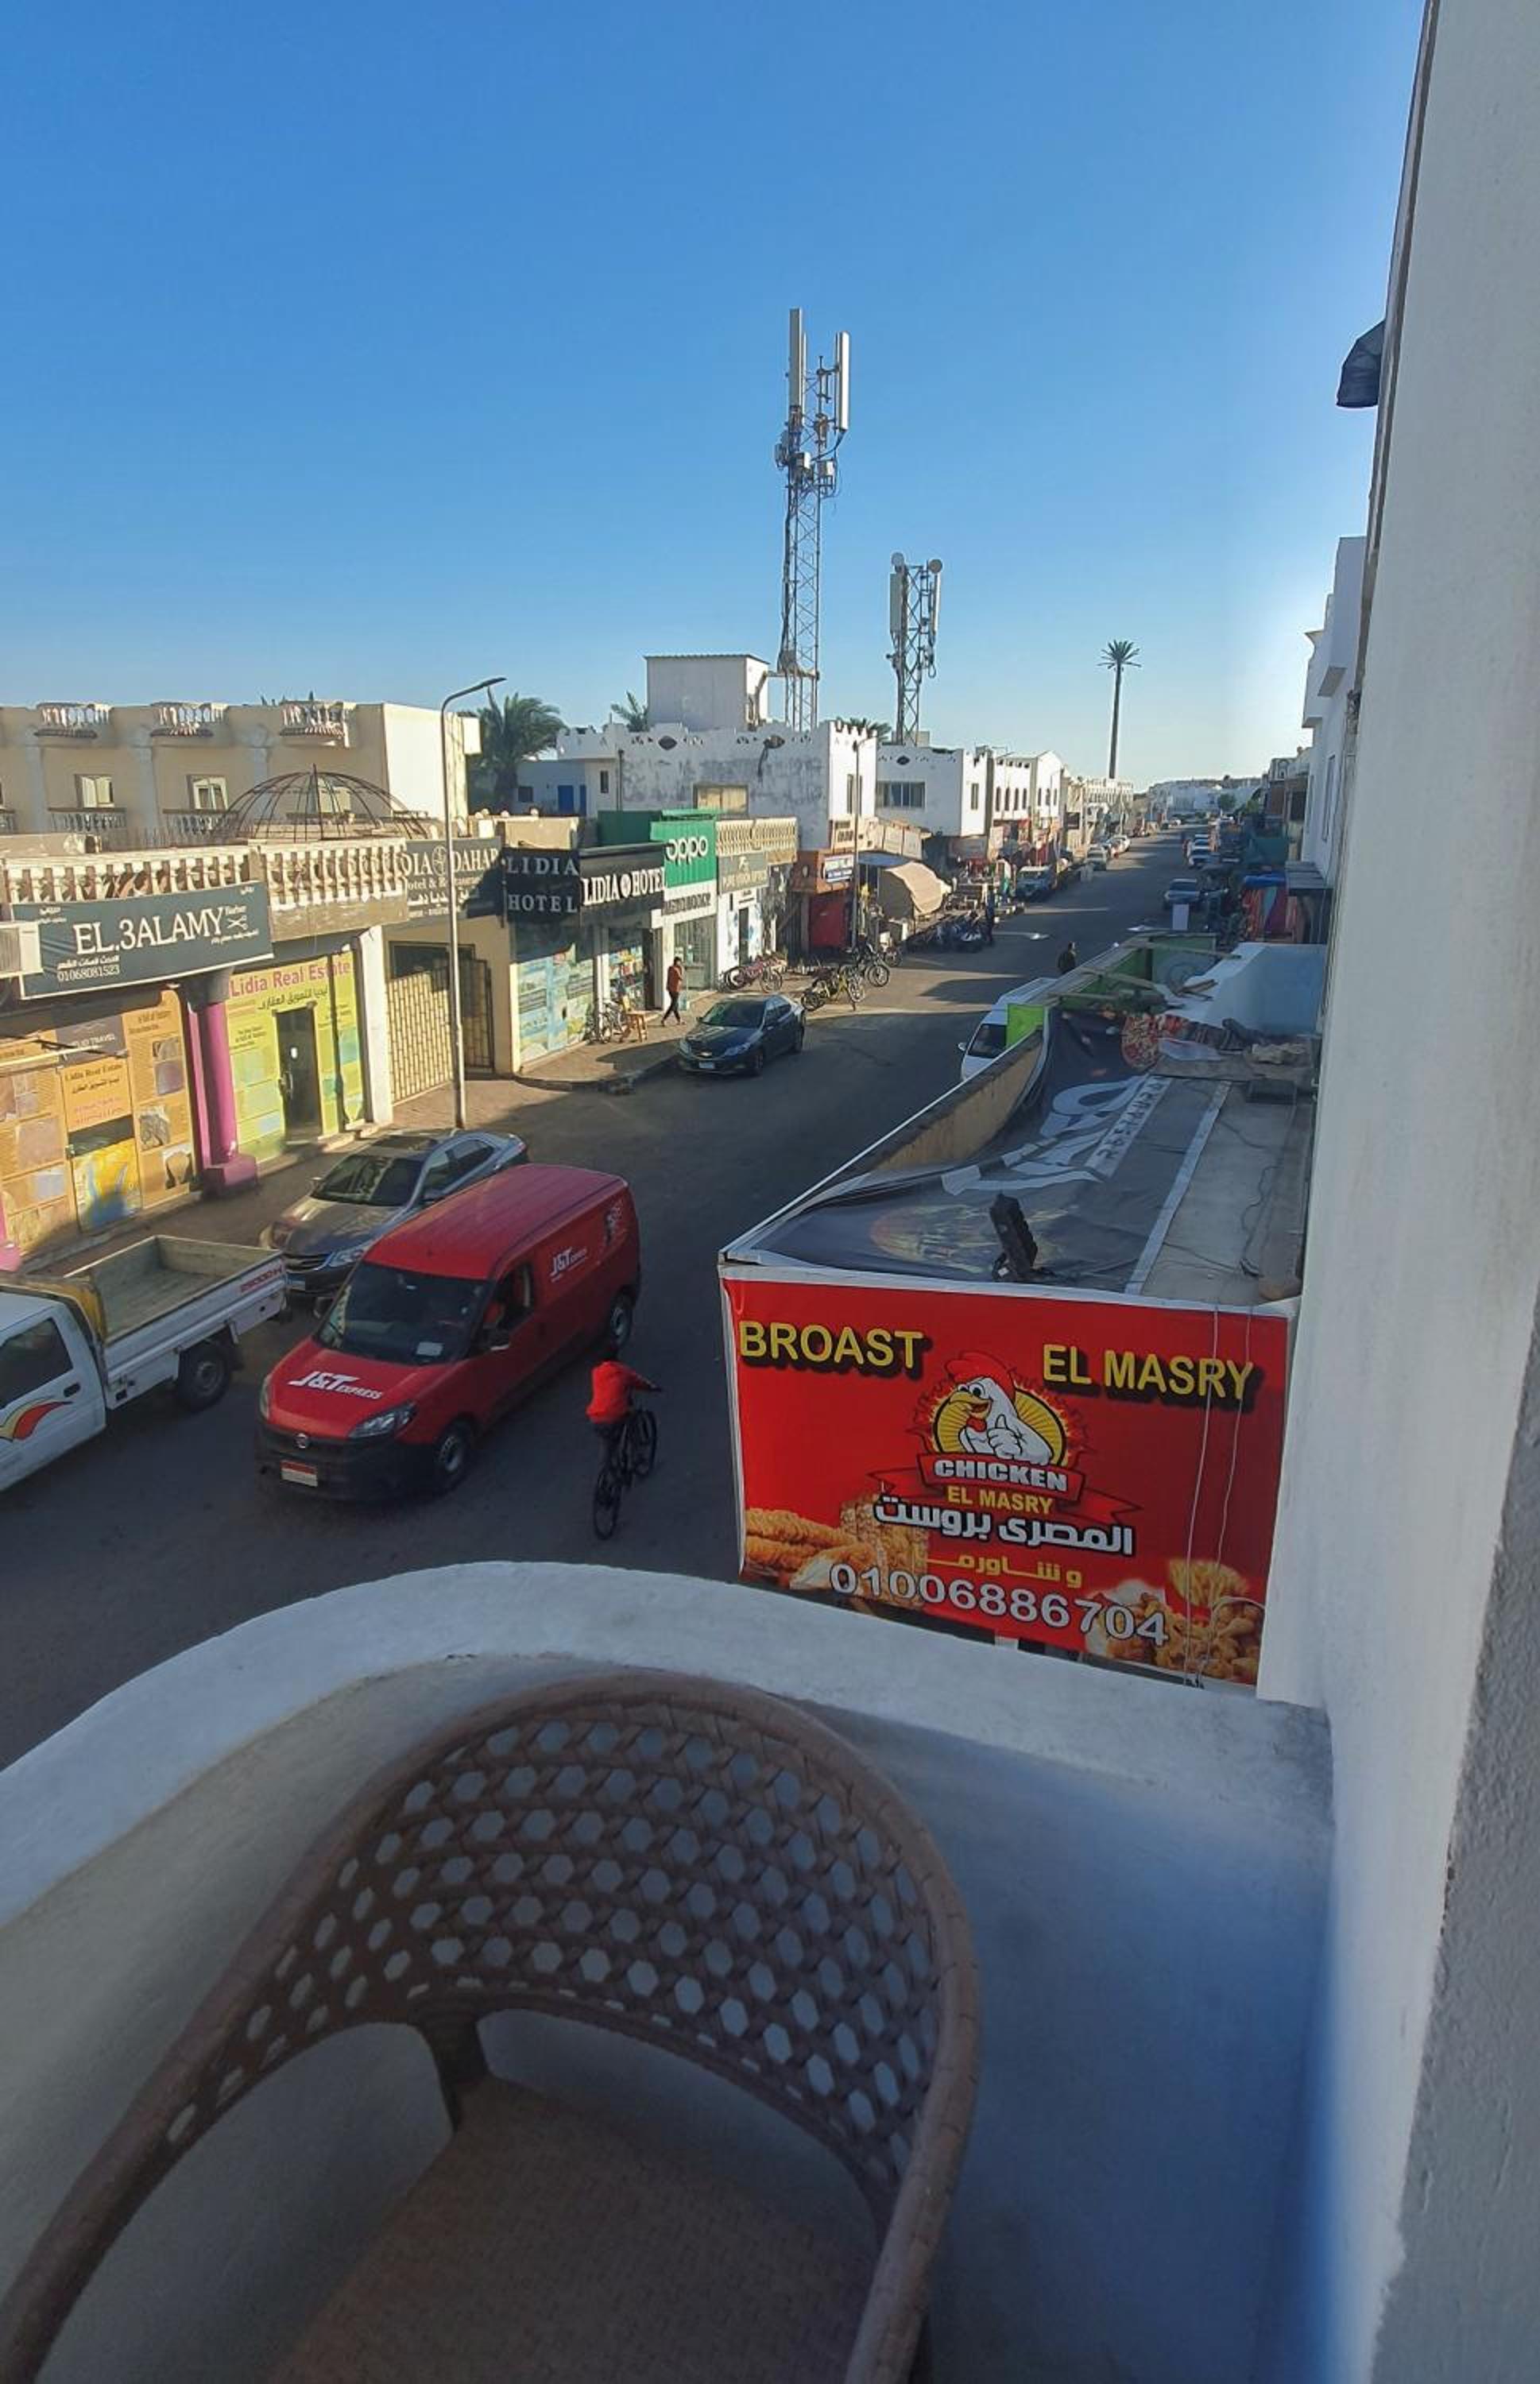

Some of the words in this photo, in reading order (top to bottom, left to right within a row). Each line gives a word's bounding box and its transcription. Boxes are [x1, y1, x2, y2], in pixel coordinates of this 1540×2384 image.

[507, 855, 578, 875] LIDIA
[666, 836, 708, 865] oppo
[508, 894, 578, 912] HOTEL
[581, 873, 620, 905] LIDIA
[73, 907, 224, 954] EL.3ALAMY
[230, 975, 268, 997] Lidia
[273, 966, 304, 988] Real
[738, 1320, 924, 1369] BROAST
[1043, 1343, 1092, 1385] EL
[1104, 1349, 1254, 1399] MASRY
[934, 1459, 1068, 1492] CHICKEN
[946, 1484, 973, 1505] EL
[979, 1489, 1055, 1515] MASRY
[875, 1496, 992, 1540] بروست
[830, 1563, 1169, 1646] 01006886704
